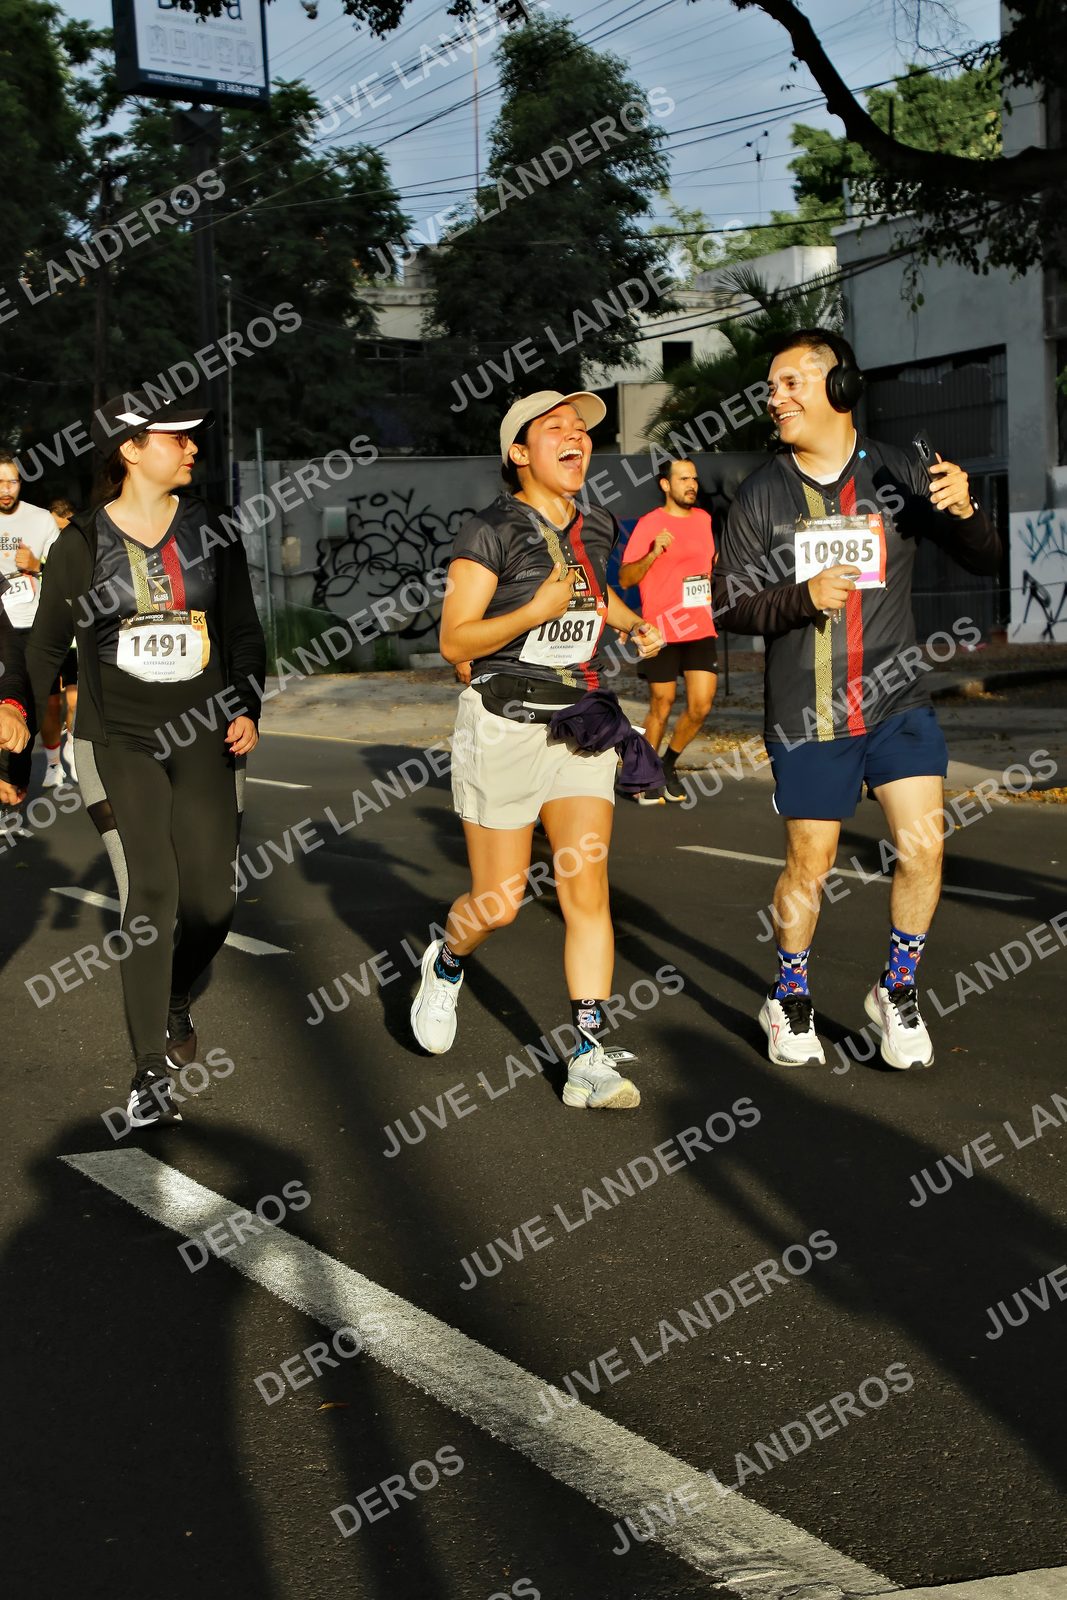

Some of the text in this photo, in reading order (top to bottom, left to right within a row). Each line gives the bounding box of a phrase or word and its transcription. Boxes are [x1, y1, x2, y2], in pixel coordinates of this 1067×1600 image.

[348, 488, 415, 514] TOY
[800, 539, 873, 564] 10985
[193, 615, 204, 624] 5K
[537, 620, 595, 642] 10881
[130, 634, 188, 657] 1491
